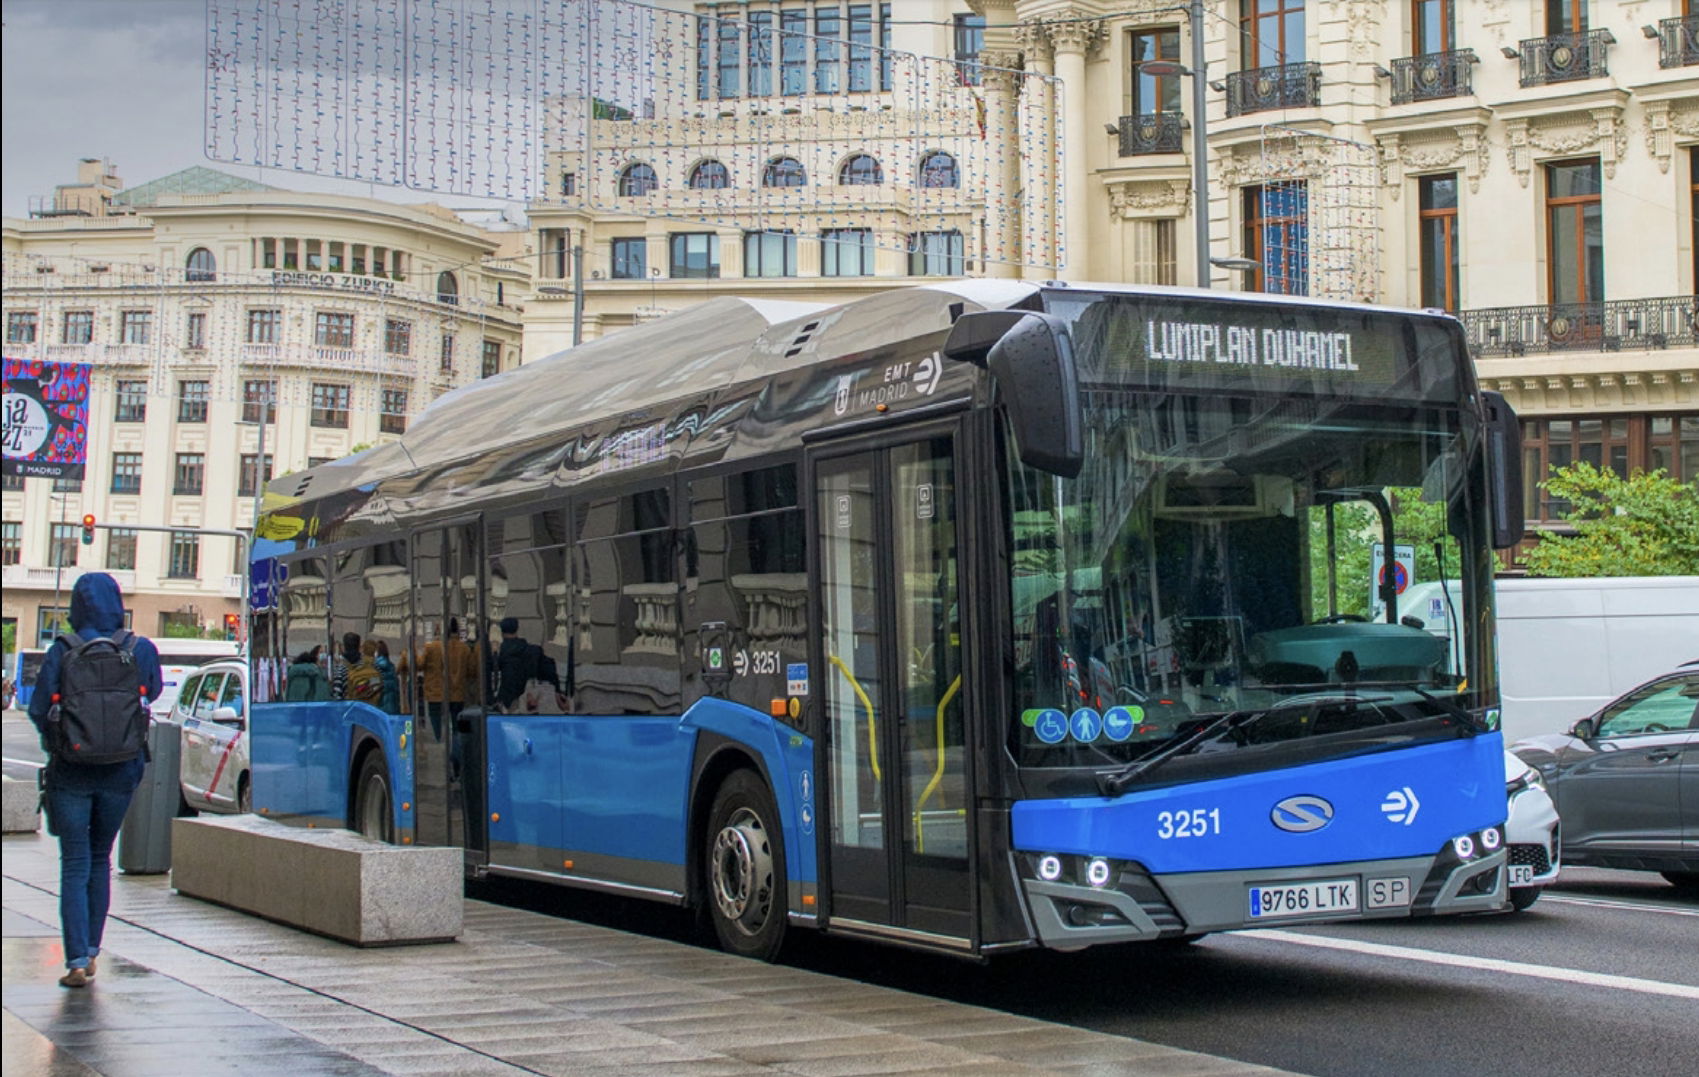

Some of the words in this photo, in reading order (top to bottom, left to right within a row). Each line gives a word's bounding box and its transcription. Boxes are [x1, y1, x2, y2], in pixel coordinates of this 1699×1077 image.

[272, 271, 335, 287] EDIFICIO
[340, 276, 395, 294] ZURICH
[1148, 321, 1257, 364] LUMIPLAN
[1261, 328, 1360, 371] DUHAMEL
[884, 362, 912, 382] EMT
[860, 382, 908, 406] MADRID
[27, 466, 62, 475] MADRID
[753, 651, 780, 673] 3251
[1157, 808, 1221, 840] 3251
[1262, 888, 1308, 912] 9766
[1315, 884, 1351, 908] LTK
[1372, 881, 1405, 903] SP
